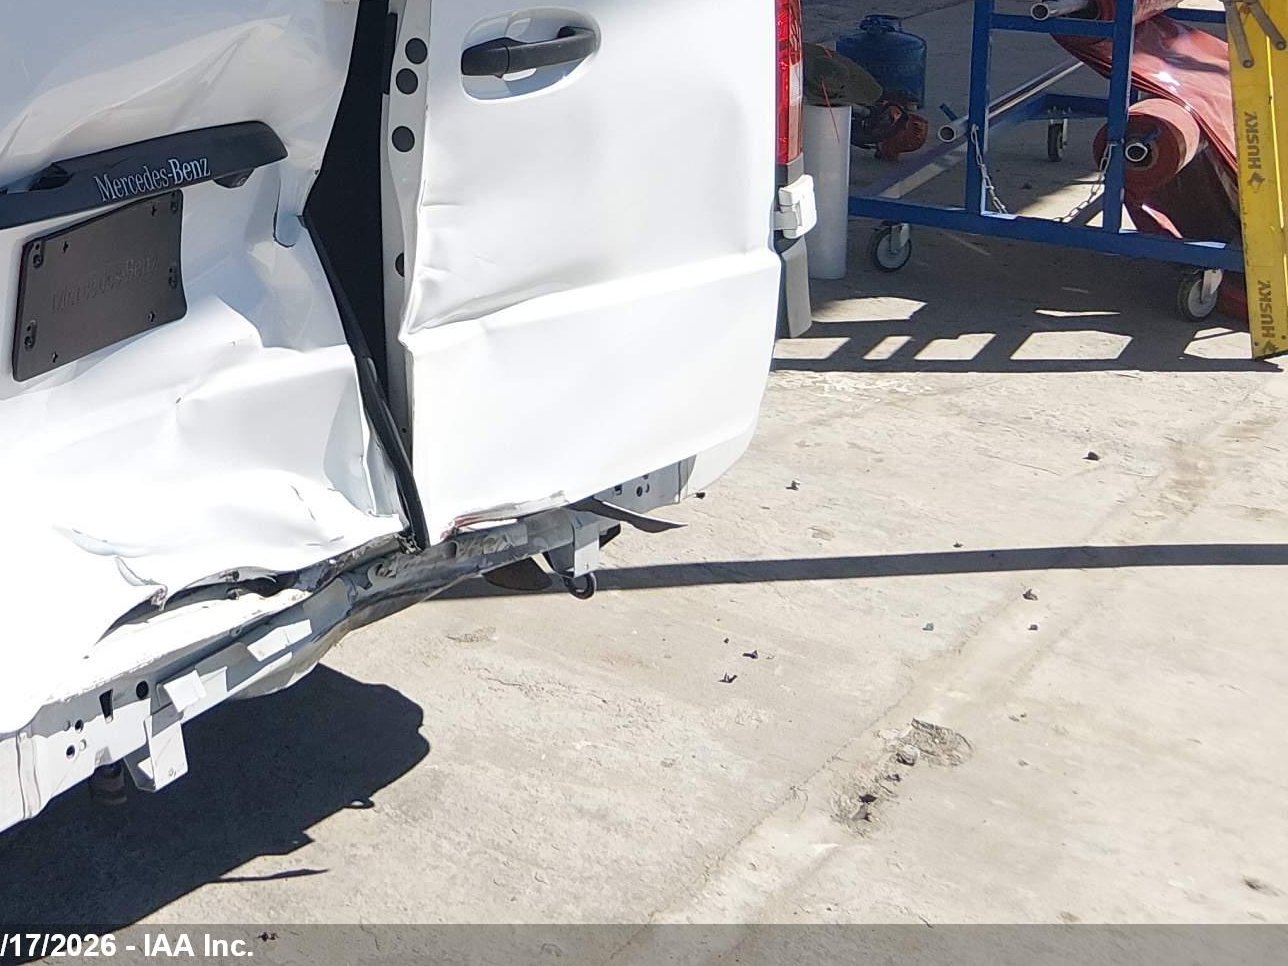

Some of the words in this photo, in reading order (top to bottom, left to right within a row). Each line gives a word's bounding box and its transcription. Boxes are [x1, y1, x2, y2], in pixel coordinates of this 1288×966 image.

[1244, 111, 1261, 170] HUSKY
[93, 158, 211, 202] Mercedes-Benz
[1258, 280, 1275, 338] HUSKY
